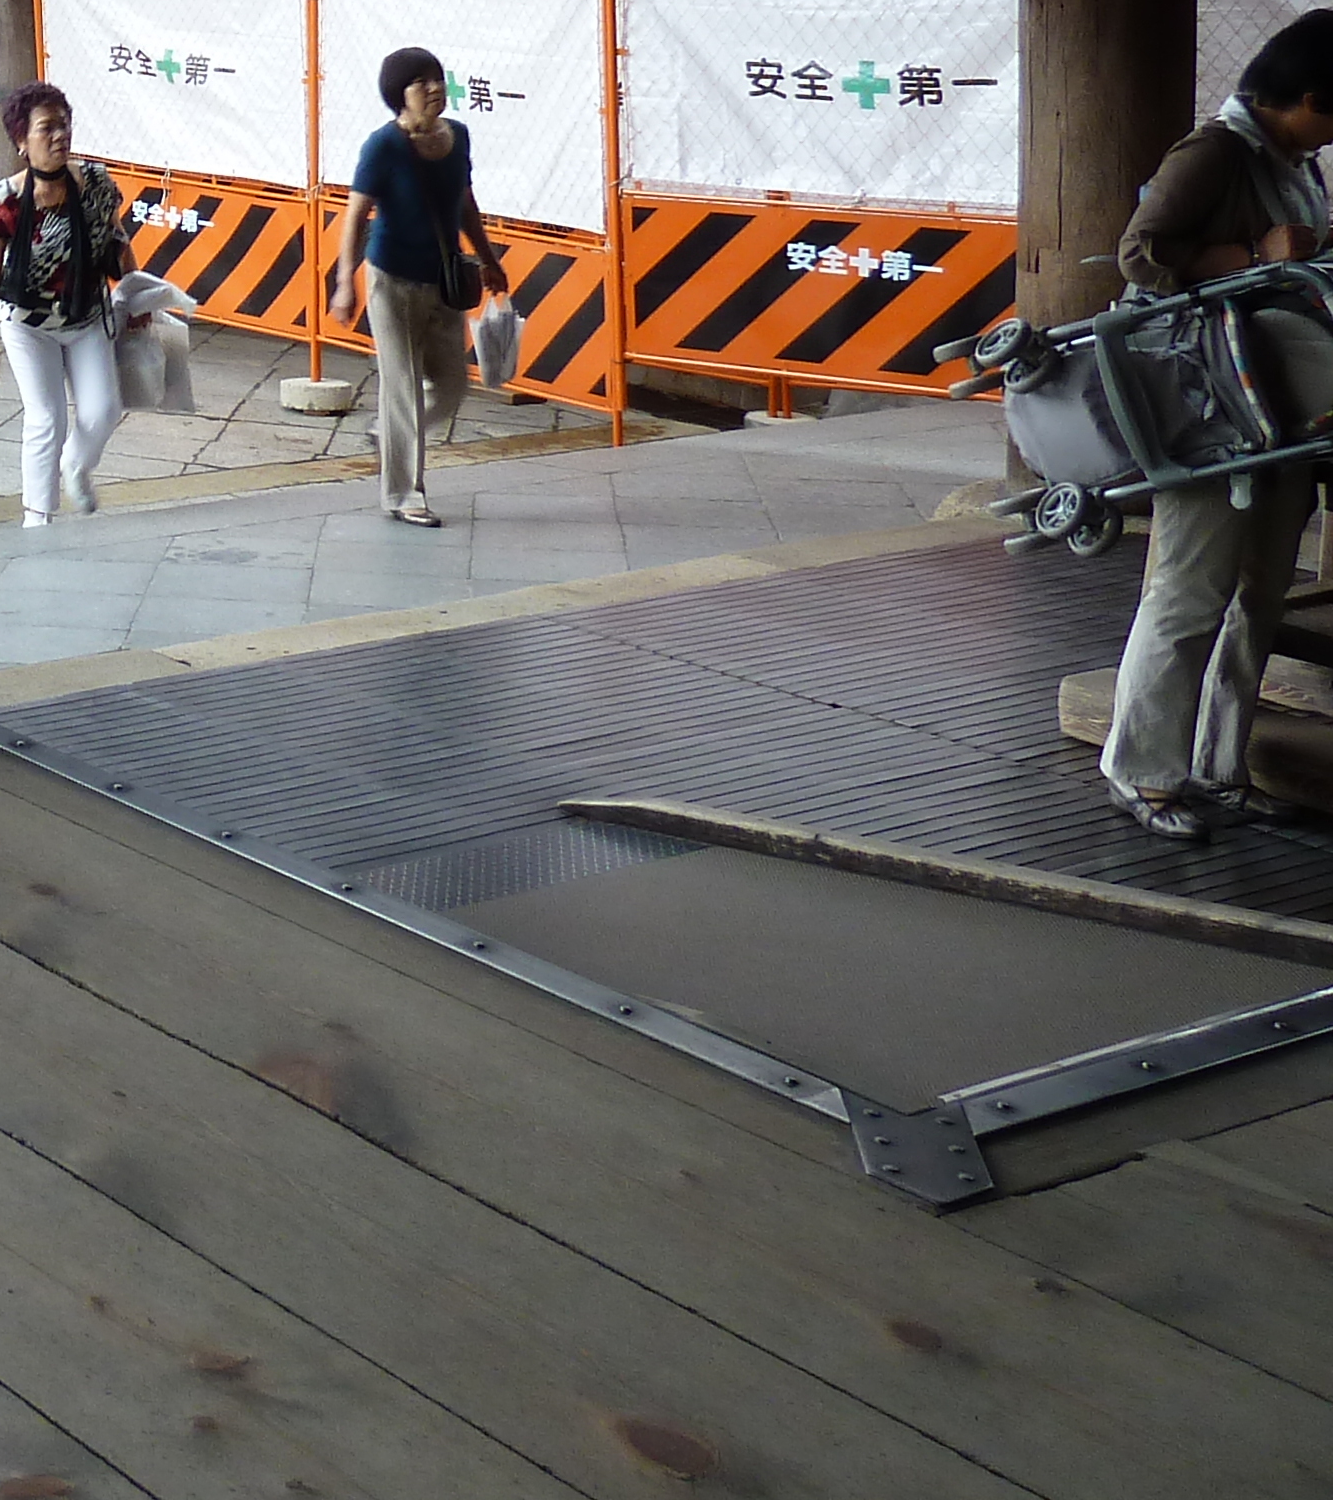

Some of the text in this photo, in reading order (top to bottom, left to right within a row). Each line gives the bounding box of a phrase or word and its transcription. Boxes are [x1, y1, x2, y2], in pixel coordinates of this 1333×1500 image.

[108, 43, 236, 85] 安全 第一
[745, 58, 998, 106] 安全 第一
[468, 75, 526, 112] 第一
[132, 200, 165, 227] 安全
[786, 242, 944, 281] 安全 第一
